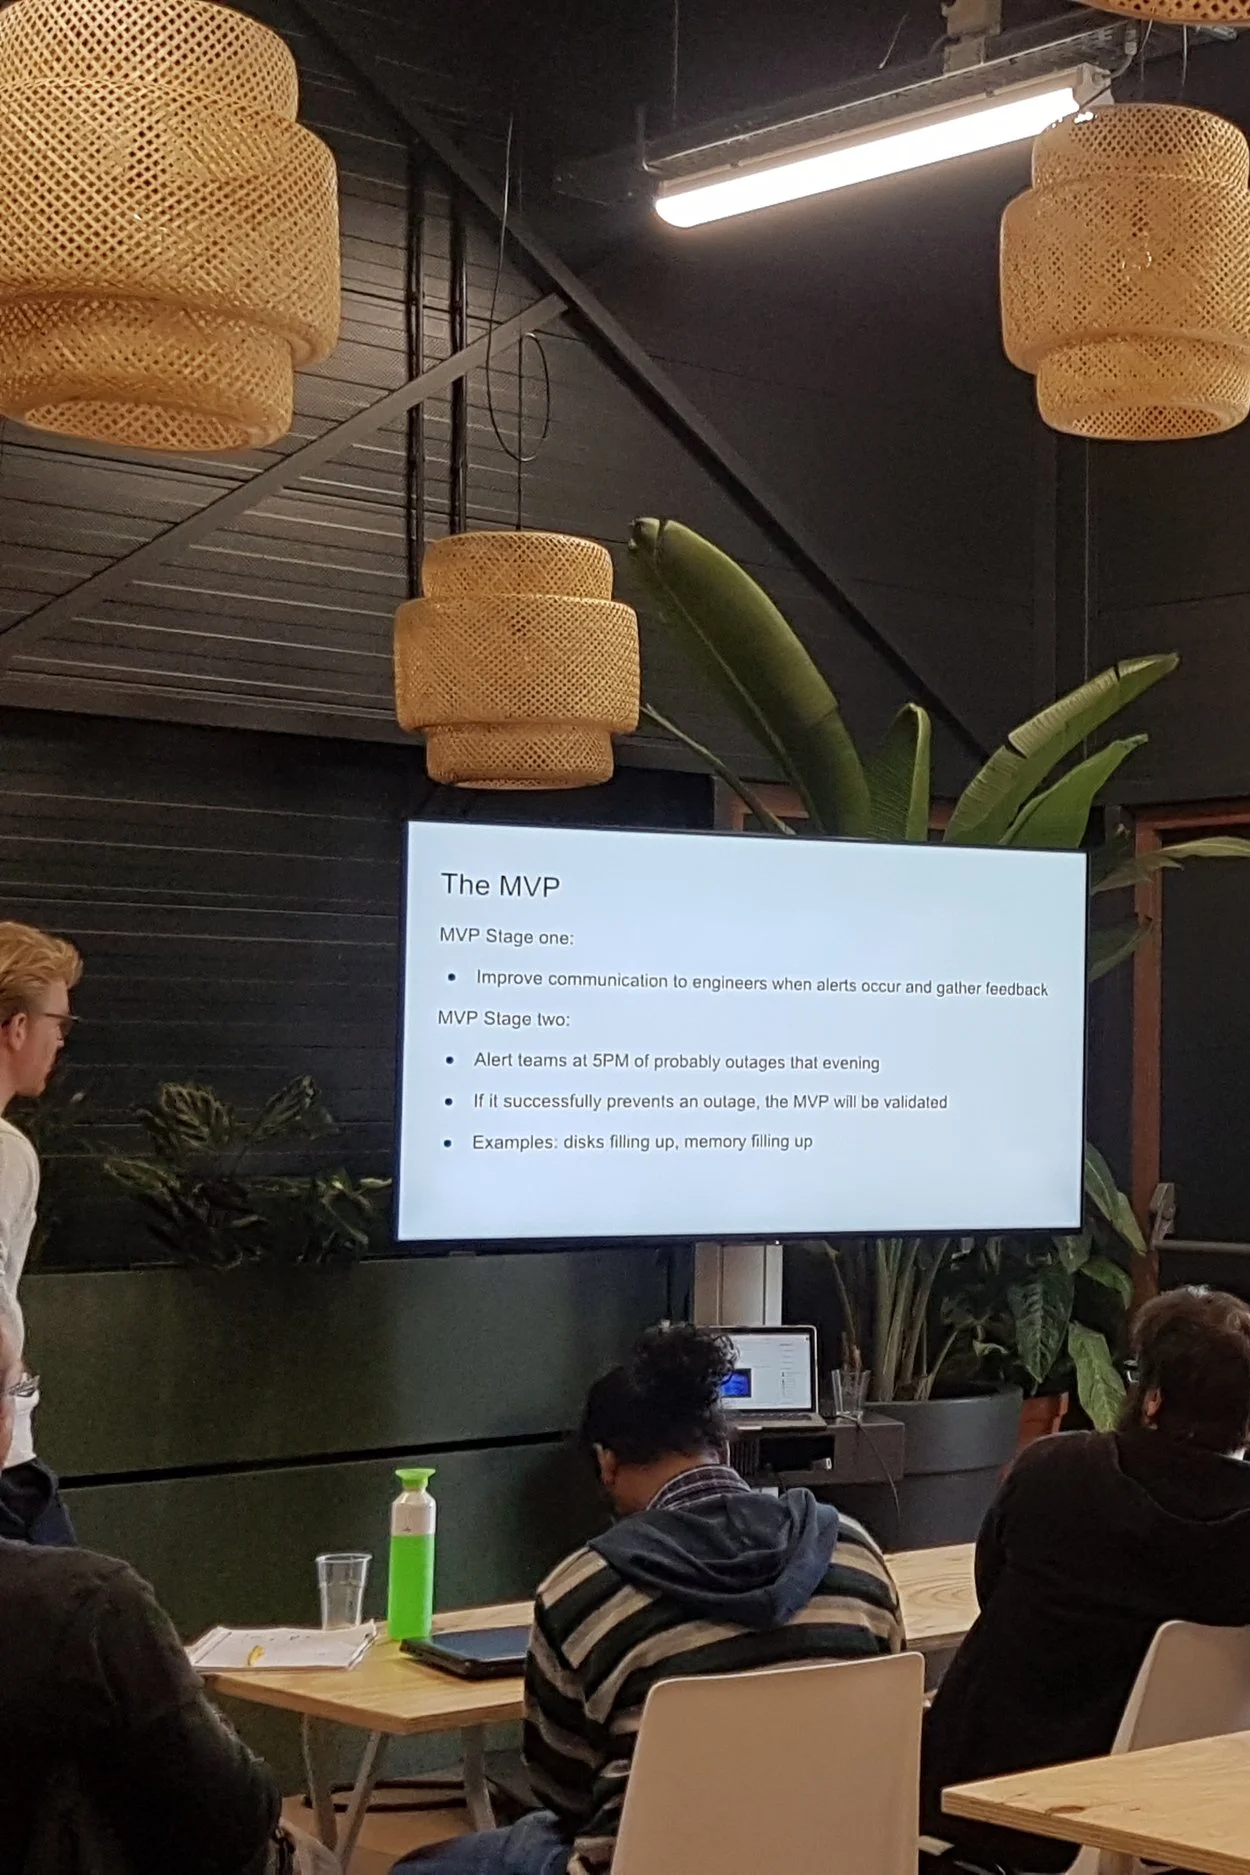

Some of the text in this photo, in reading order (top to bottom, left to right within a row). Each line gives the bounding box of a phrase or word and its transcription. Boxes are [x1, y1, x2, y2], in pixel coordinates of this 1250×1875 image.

[440, 872, 560, 898] The MVP
[440, 926, 574, 948] MVP Stage one:
[477, 968, 1049, 998] Improve communication to engineers when alerts occur and gather feedback
[438, 1009, 570, 1030] MVP Stage two:
[473, 1051, 880, 1074] Alert teams at 5PM of probably outages that evening
[474, 1093, 948, 1112] If it successfully prevents an outage, the MVP will be validated
[472, 1133, 813, 1153] Examples: disks filling up, memory filling up
